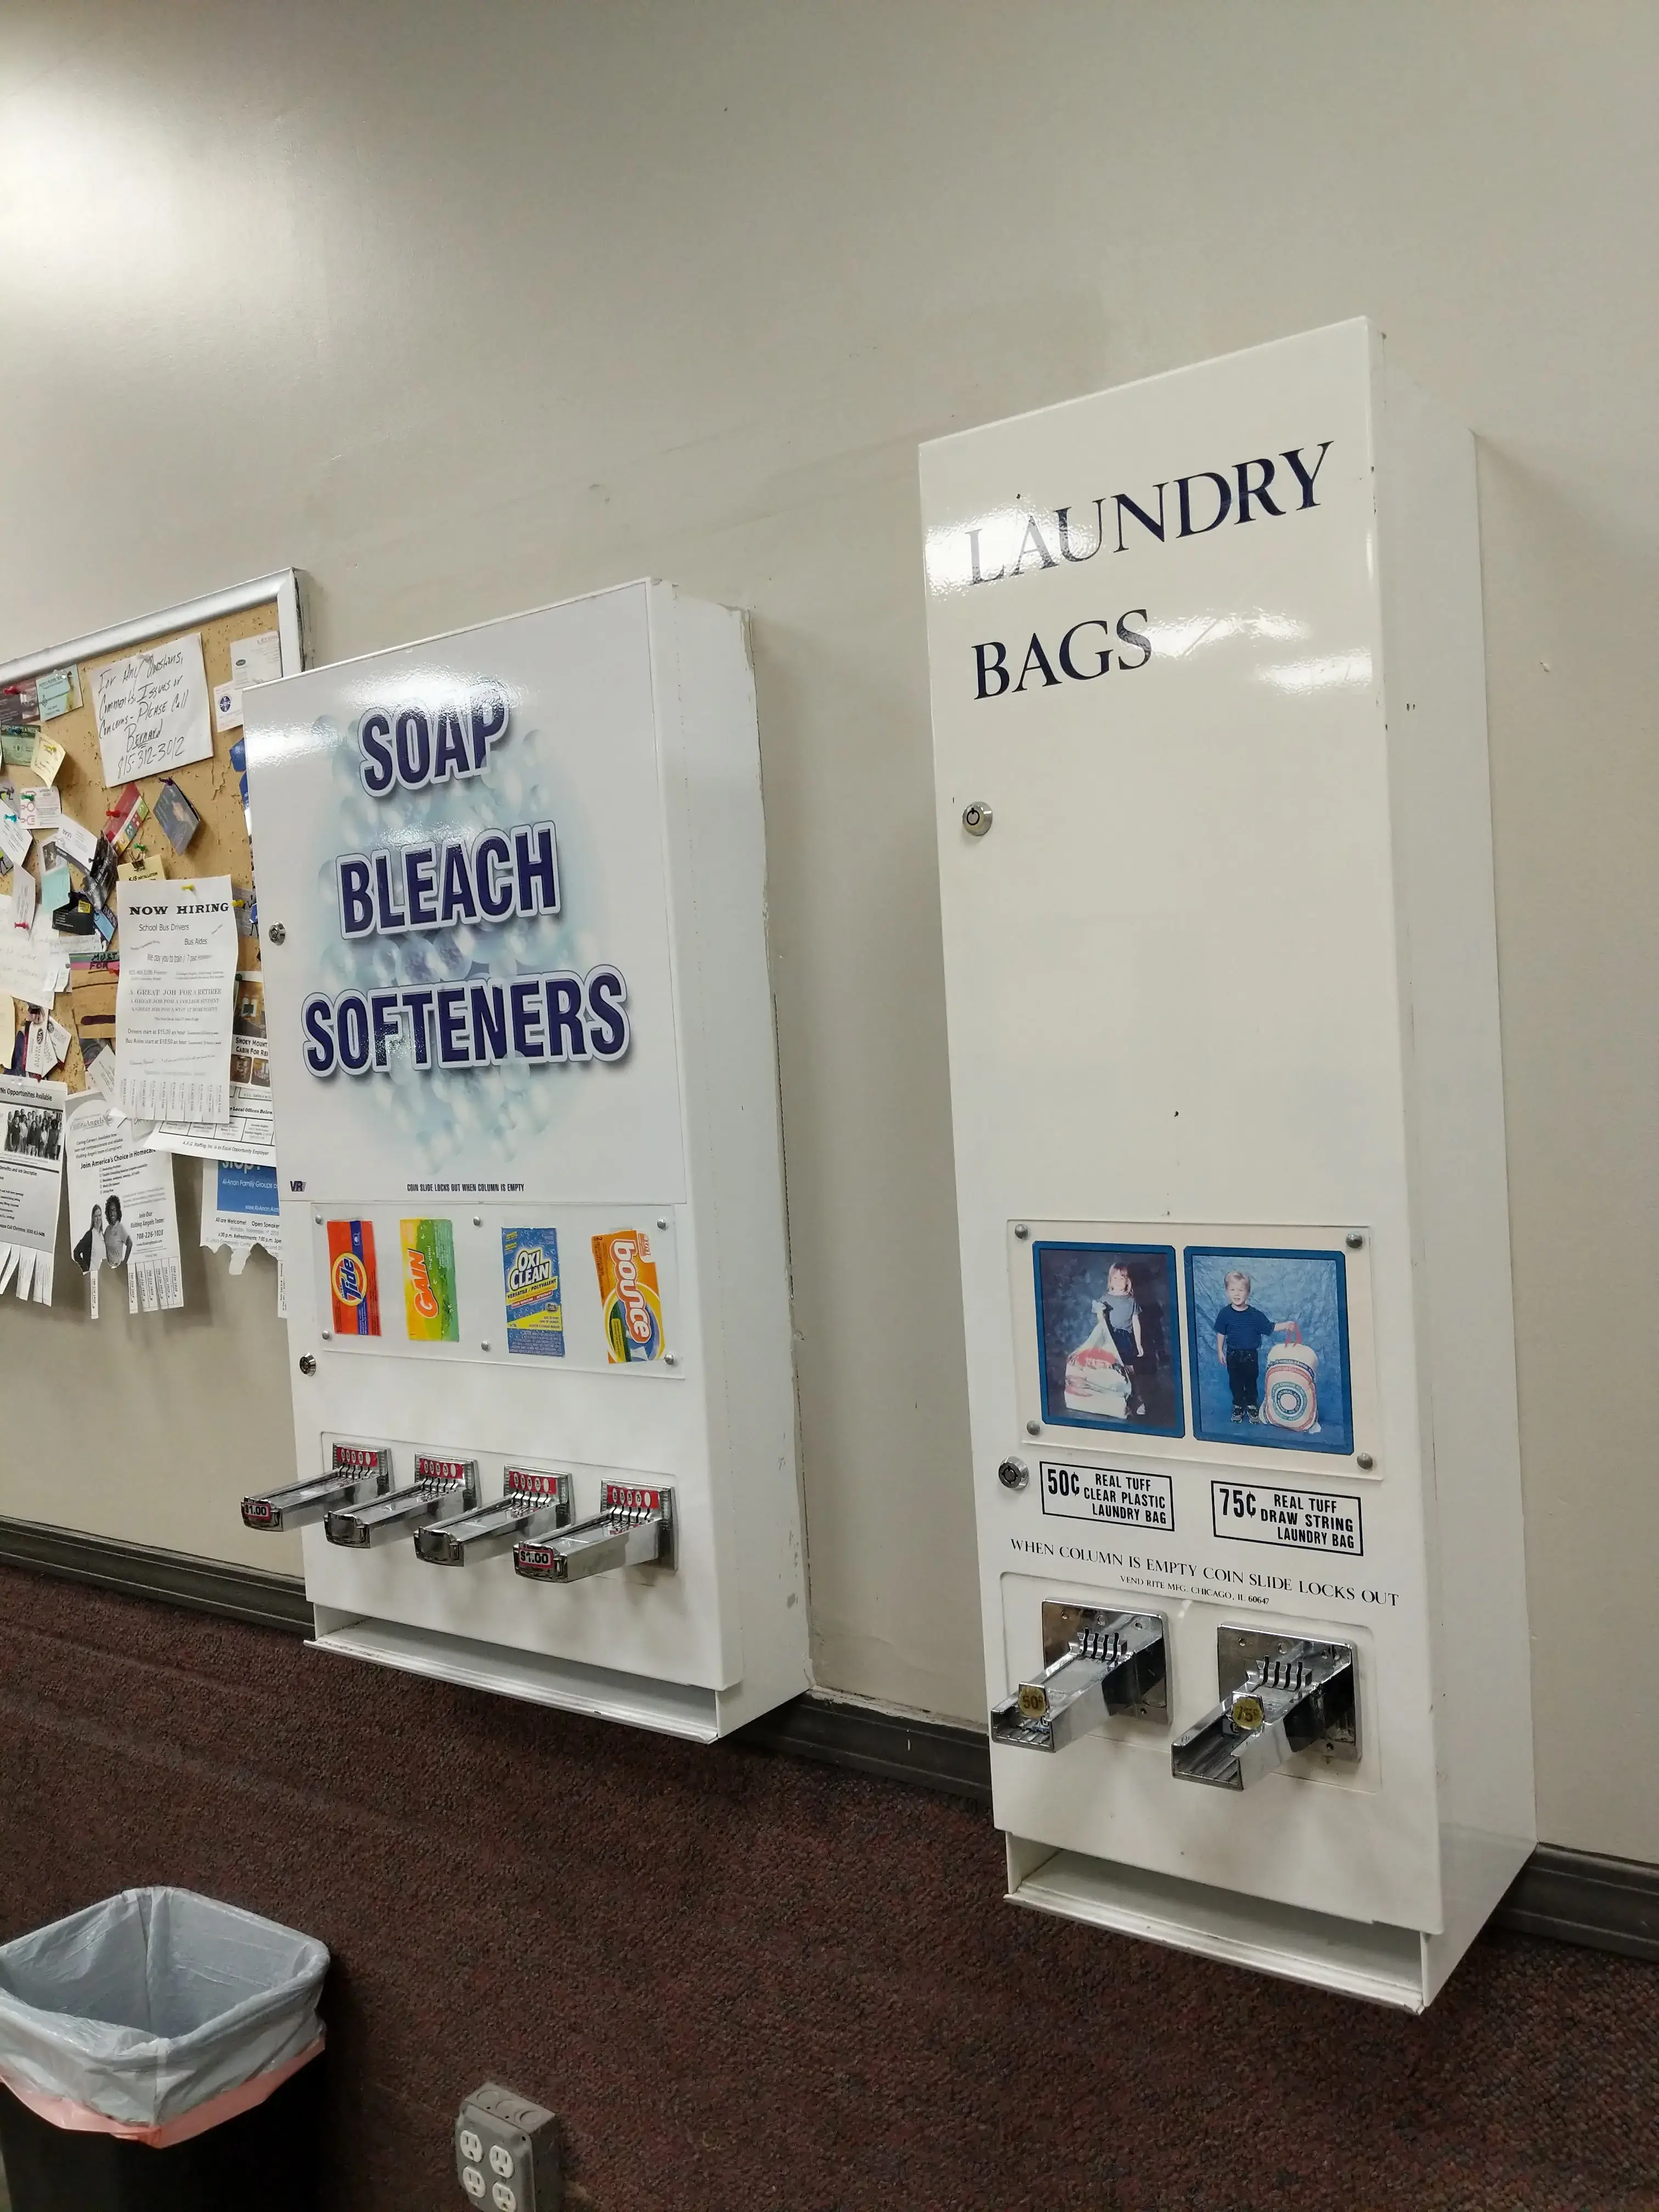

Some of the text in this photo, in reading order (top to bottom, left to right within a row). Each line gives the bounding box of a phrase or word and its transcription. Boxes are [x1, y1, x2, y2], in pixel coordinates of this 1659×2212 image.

[964, 441, 1334, 586] LAUNDRY
[971, 609, 1152, 700] BAGS
[358, 678, 511, 797] SOAP
[336, 821, 561, 939] BLEACH
[128, 902, 229, 915] NOW HIRING
[301, 964, 630, 1077] SOFTENERS
[36, 1092, 53, 1101] Available
[80, 1161, 91, 1170] Join
[92, 1157, 113, 1166] America's
[114, 1154, 128, 1162] Choice
[407, 1183, 524, 1192] COIN SLIDE LOCKS OUT WHEN COLUMN IS EMPTY
[137, 1229, 163, 1240] 708-226-1028
[517, 1250, 541, 1272] OXI
[340, 1257, 363, 1300] Tide
[407, 1248, 439, 1319] GAIN
[510, 1261, 550, 1291] CLEAN
[610, 1239, 651, 1342] bounce
[1047, 1469, 1080, 1497] 50¢
[1095, 1474, 1151, 1492] REAL TUFF
[1084, 1487, 1165, 1509] CLEAR PLASTIC
[1220, 1488, 1256, 1518] 75¢
[1274, 1494, 1336, 1514] REAL TUFF
[245, 1504, 267, 1516] $1.00
[1092, 1503, 1166, 1524] LAUNDRY BAG
[1261, 1509, 1353, 1532] DRAW STRING
[1278, 1527, 1354, 1549] LAUNDRY BAG
[521, 1551, 549, 1564] $1.00
[1011, 1538, 1399, 1606] WHEN COLUMN IS EMPTY COIN SLIDE LOCKS OUT
[1120, 1575, 1144, 1585] VEND
[1147, 1579, 1165, 1589] RITE
[1167, 1584, 1188, 1593] MFG.
[1191, 1587, 1235, 1600] CHICAGO,
[1248, 1595, 1269, 1605] 60647
